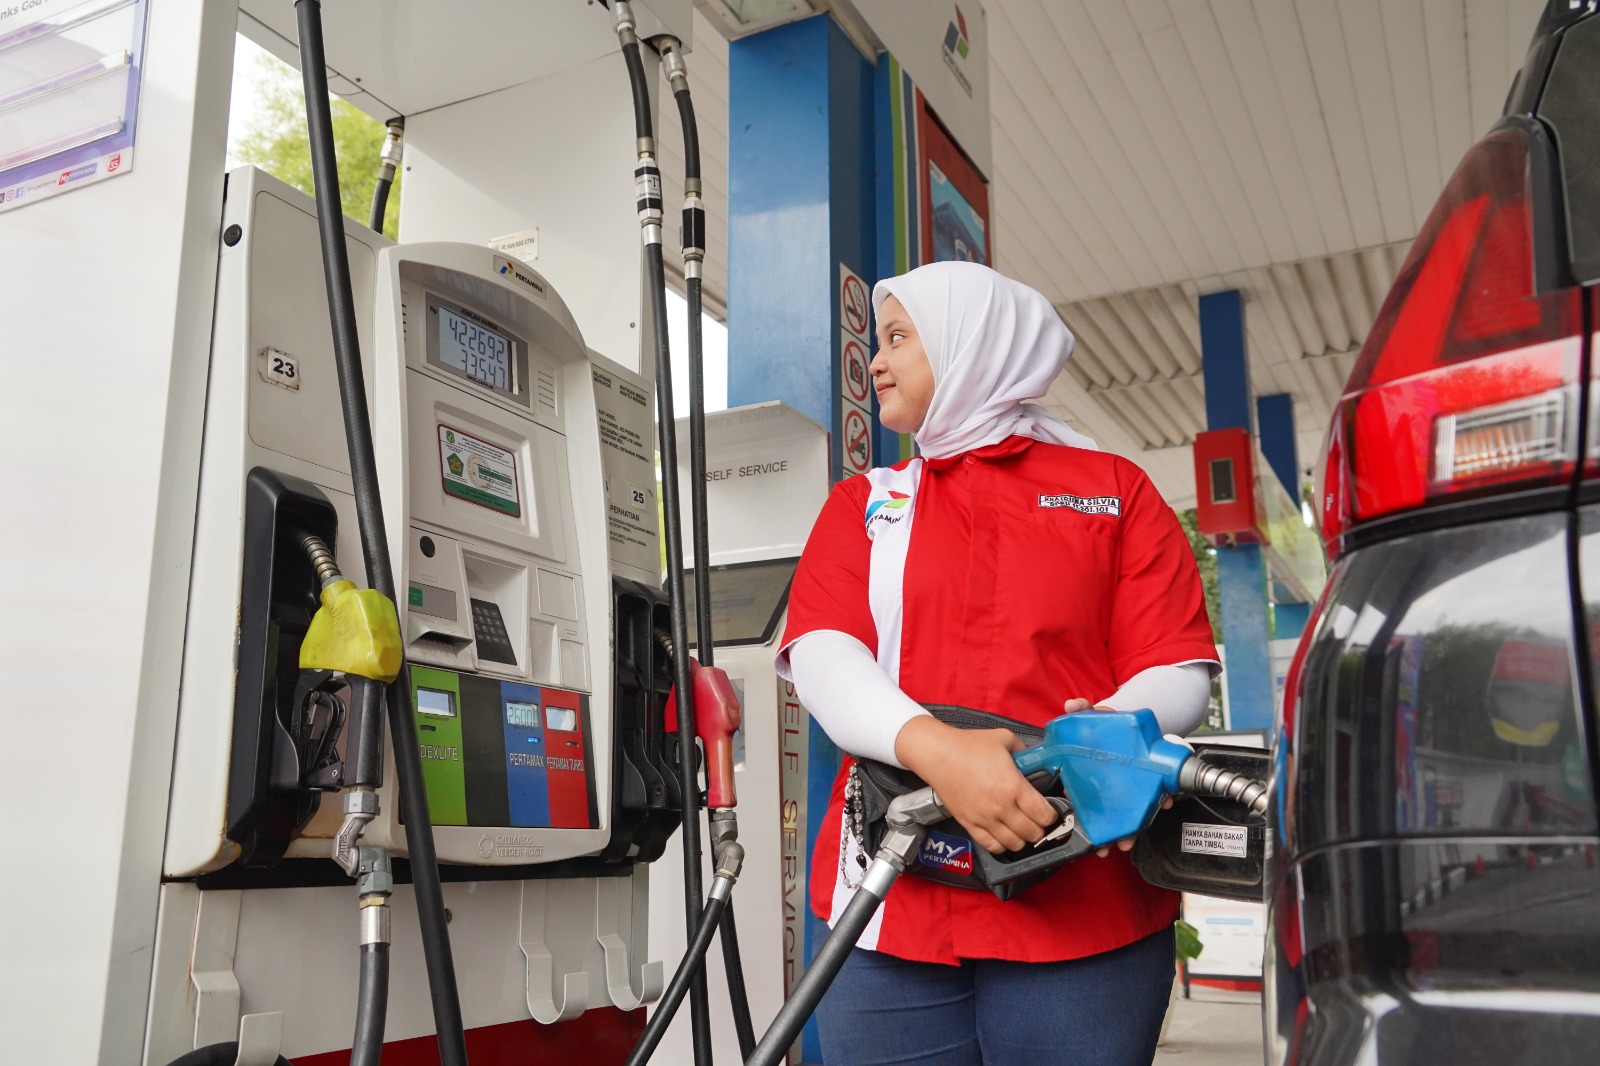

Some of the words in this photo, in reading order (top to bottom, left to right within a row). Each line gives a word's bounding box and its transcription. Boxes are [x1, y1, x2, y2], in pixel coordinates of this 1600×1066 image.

[515, 271, 543, 293] PERTAMINA
[449, 316, 504, 365] 422692
[273, 357, 295, 378] 23
[461, 348, 505, 390] 33547
[450, 458, 463, 472] 25
[705, 468, 733, 482] SELF
[738, 460, 788, 478] SERVICE
[633, 490, 645, 504] 25
[1086, 498, 1117, 507] SILVIA
[609, 504, 640, 522] PERHATIAN
[419, 744, 459, 761] DEXLITE
[509, 752, 545, 768] PERTAMAX
[546, 756, 570, 771] PERTAMAX
[569, 758, 585, 772] TURBO
[496, 836, 533, 845] GILBARCO
[1185, 829, 1204, 838] HANYA
[1203, 831, 1223, 840] BAHAN
[1223, 832, 1244, 841] BAKAR
[496, 847, 544, 857] VEEDER-ROOT
[1185, 838, 1204, 848] TANPA
[1204, 840, 1225, 850] TIMBAL
[923, 854, 970, 869] PERTAMINA
